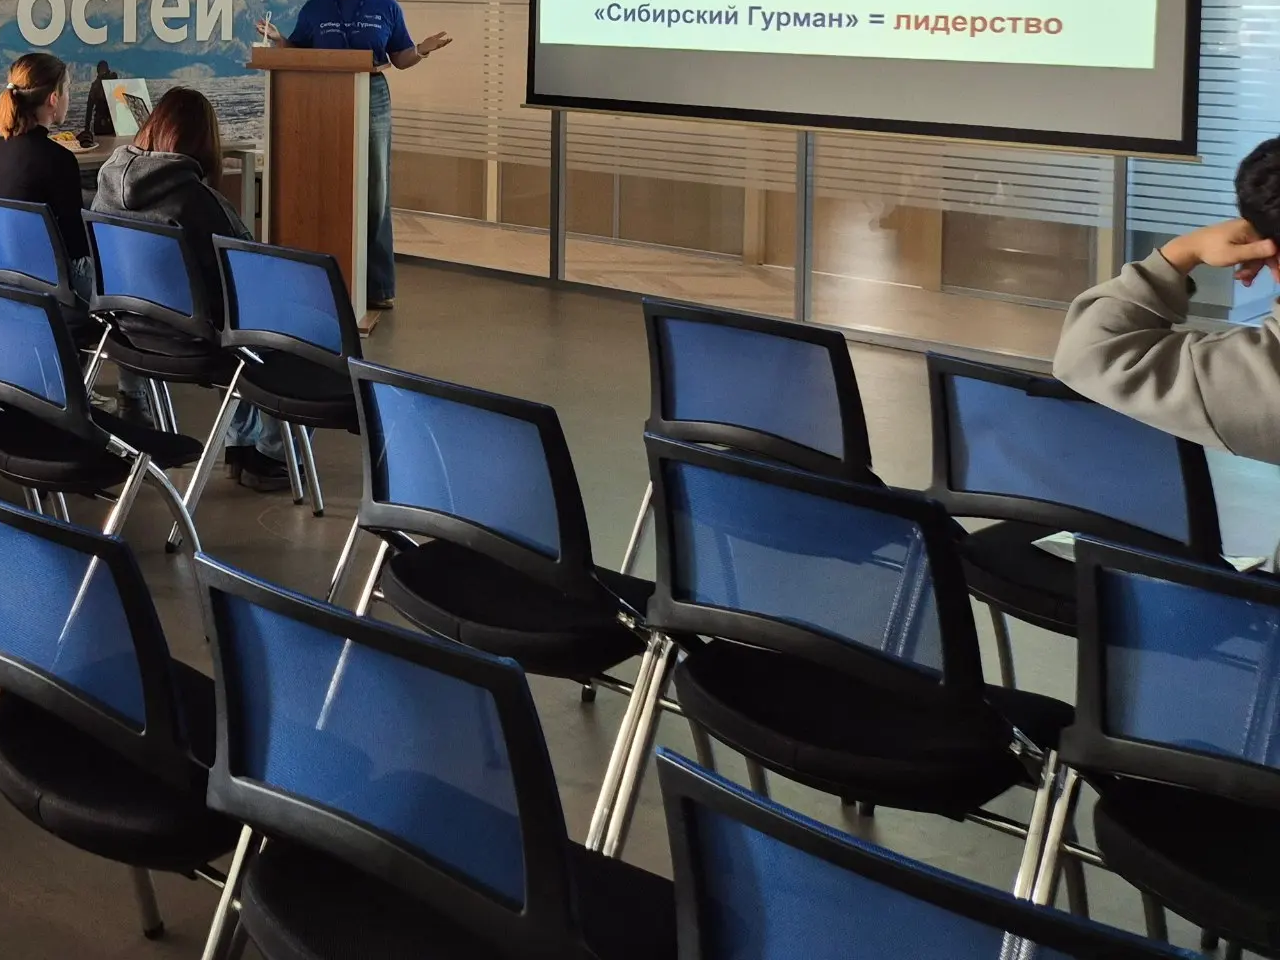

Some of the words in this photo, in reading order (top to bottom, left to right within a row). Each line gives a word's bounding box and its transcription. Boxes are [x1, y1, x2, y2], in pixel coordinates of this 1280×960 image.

[594, 2, 738, 31] «Сибирский
[748, 6, 858, 31] Гурман»
[894, 14, 1064, 38] лидерство
